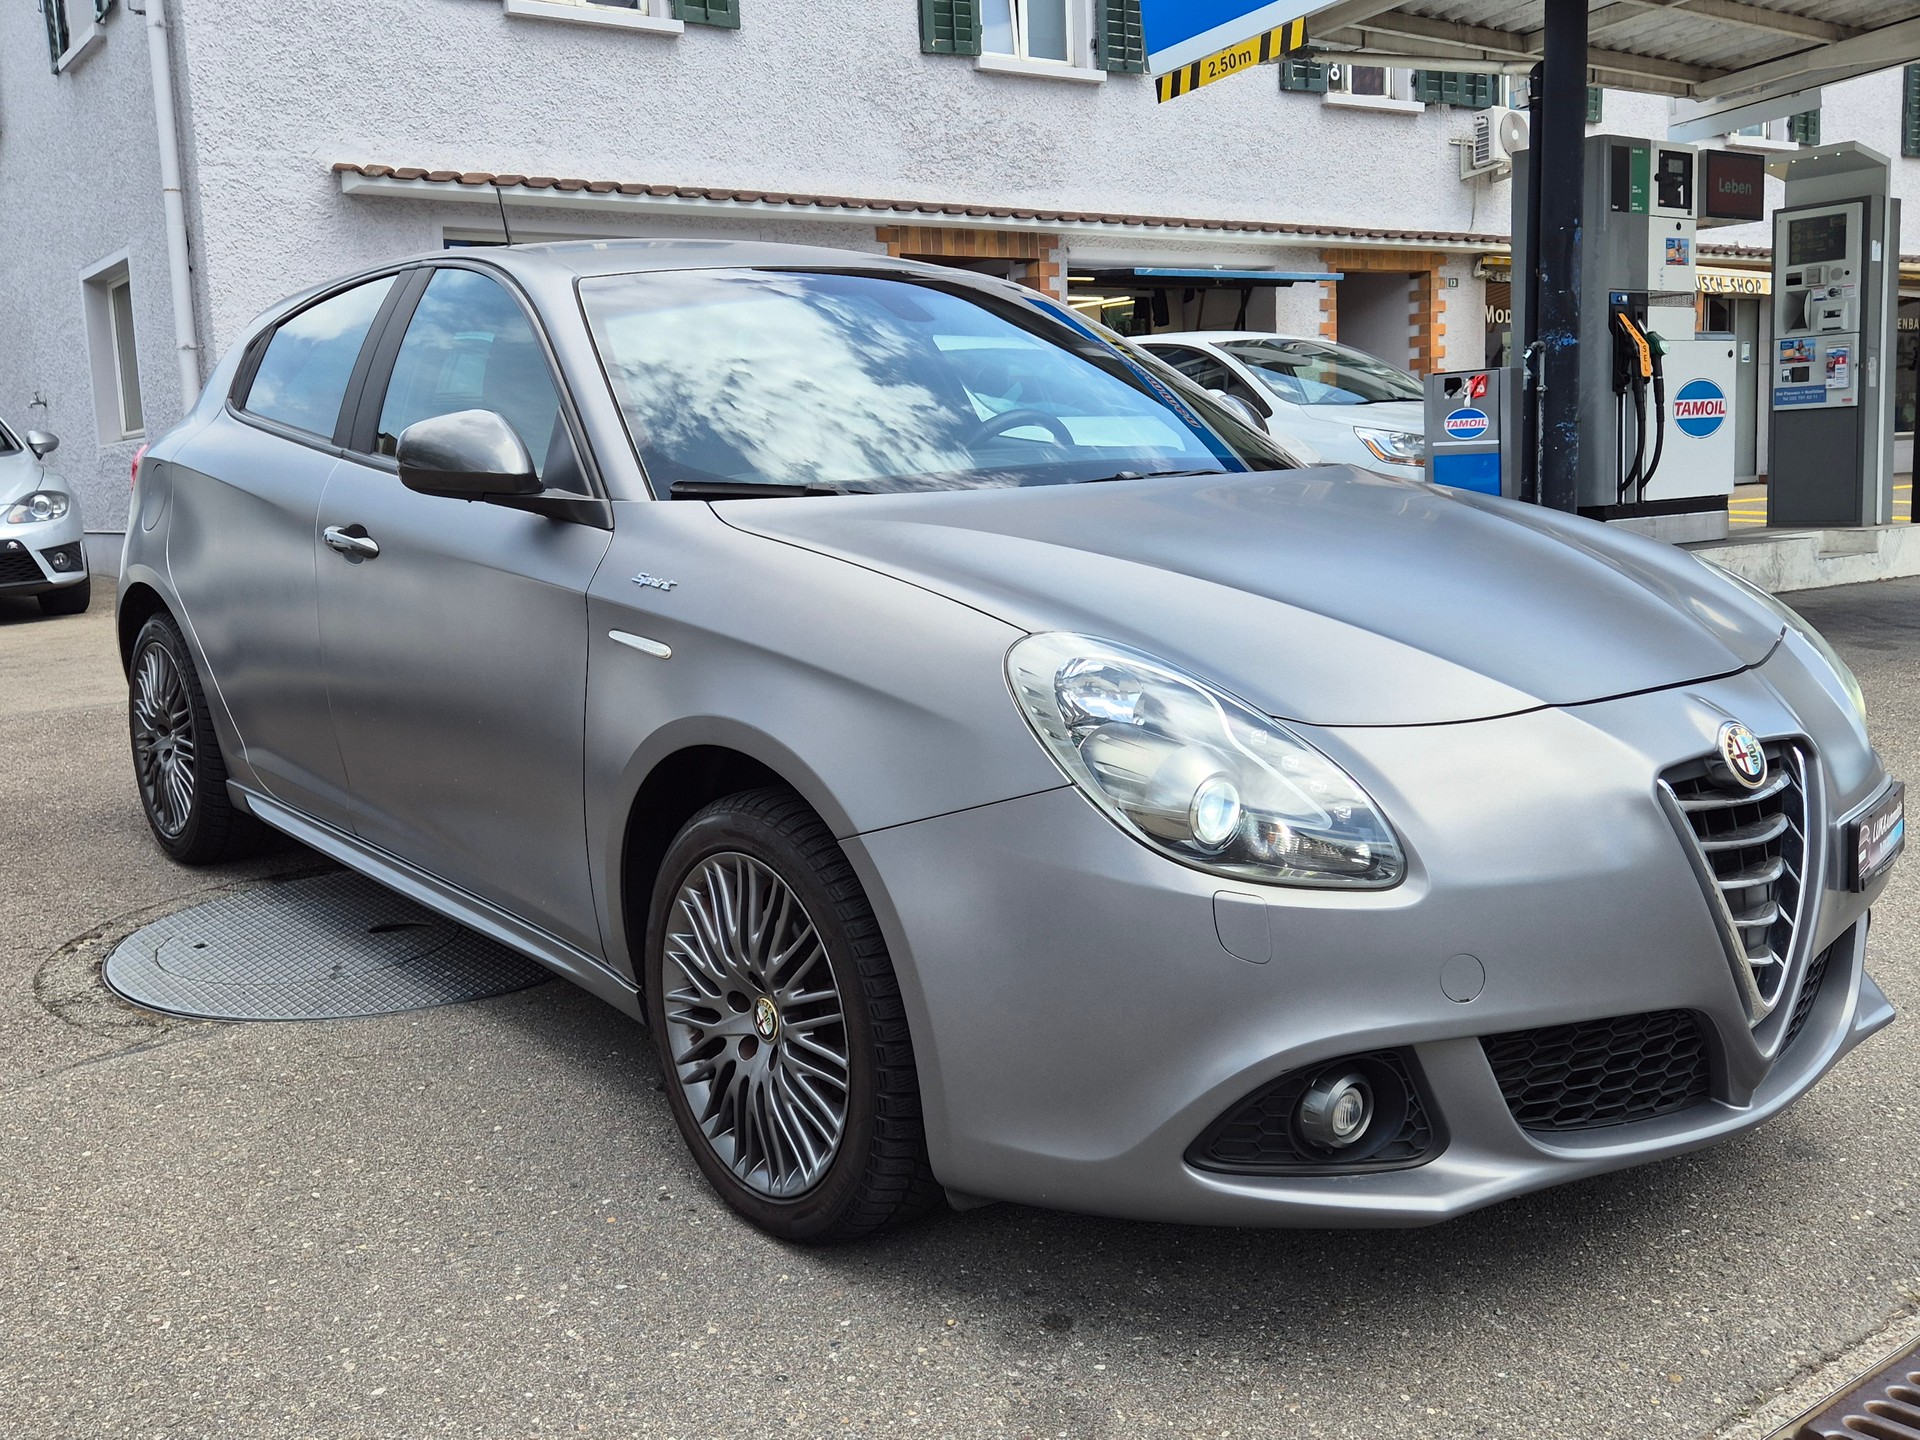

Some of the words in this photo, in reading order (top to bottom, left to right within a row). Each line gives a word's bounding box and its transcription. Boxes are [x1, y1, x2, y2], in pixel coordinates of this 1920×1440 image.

[1677, 184, 1684, 205] 1
[1718, 177, 1752, 195] Leben
[1627, 324, 1650, 372] DIESEL
[1675, 400, 1726, 416] TAMOIL
[1446, 419, 1487, 428] TAMOIL
